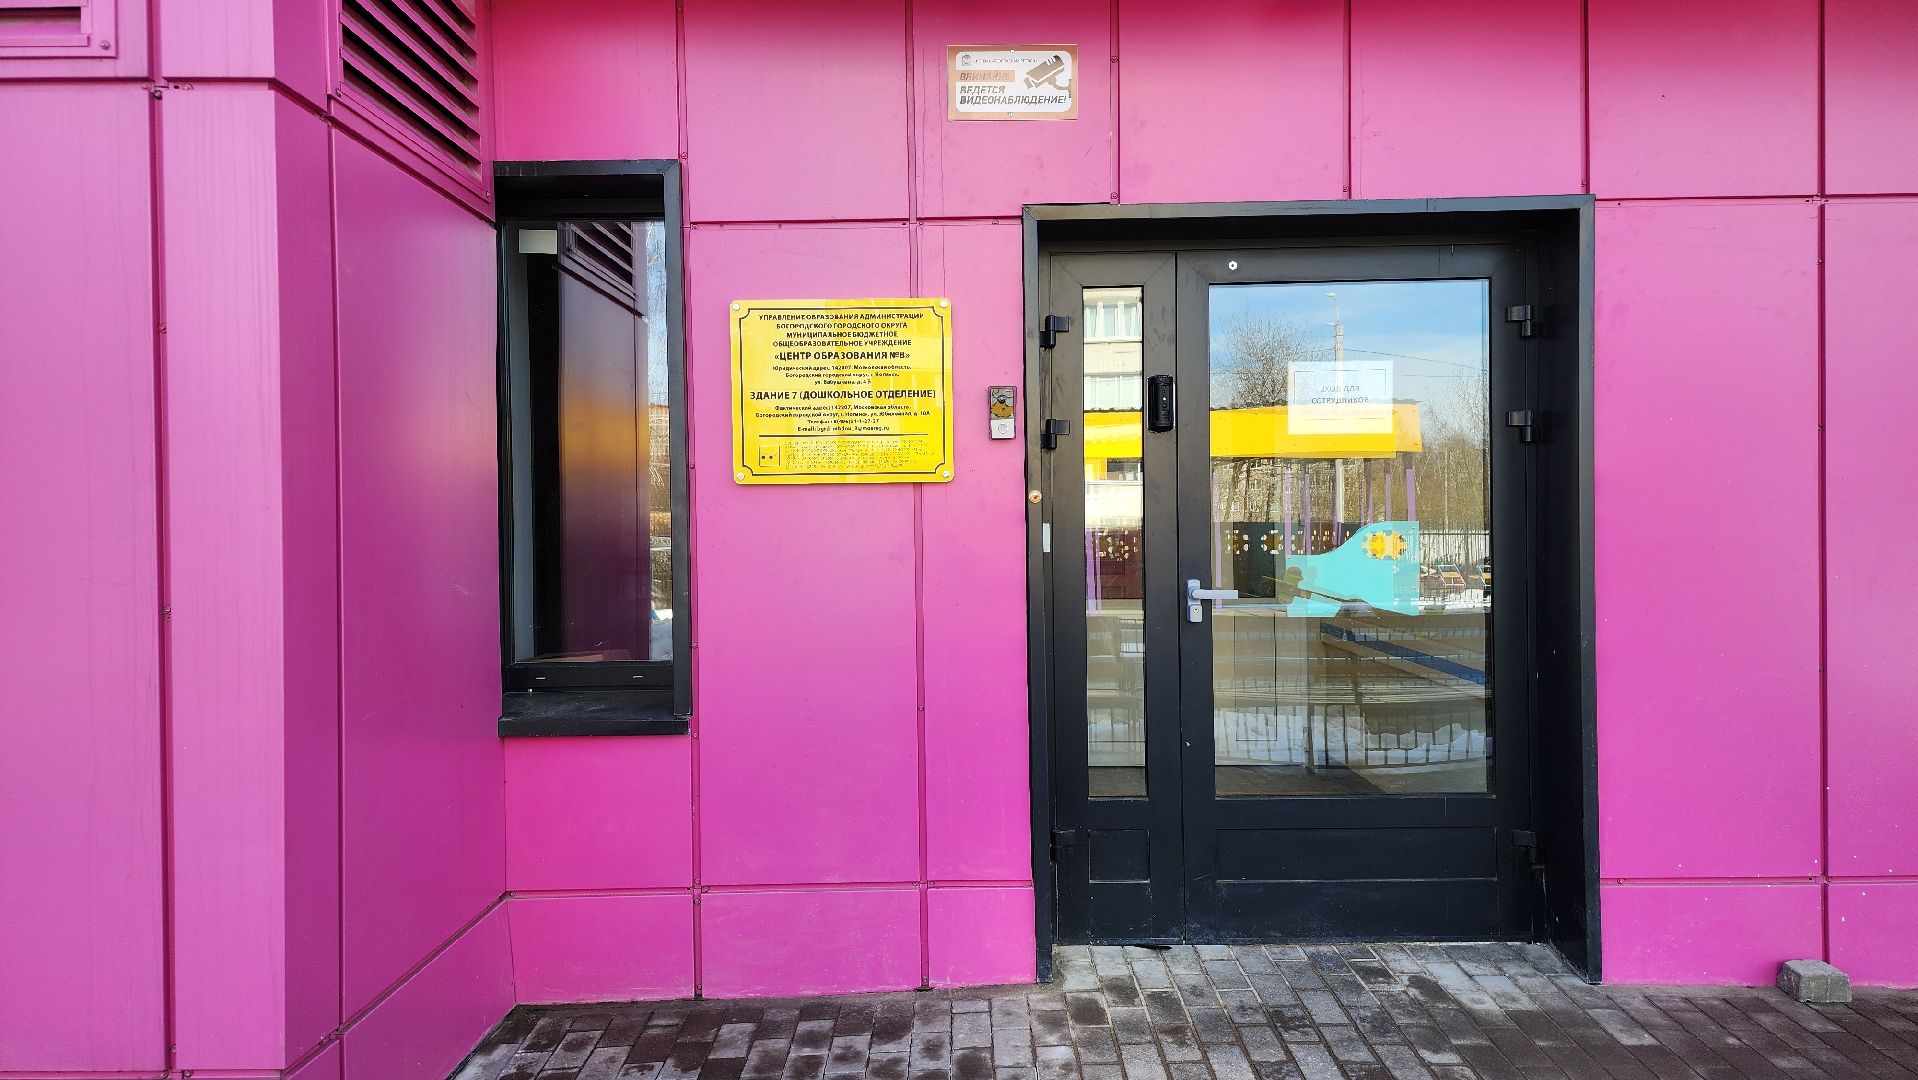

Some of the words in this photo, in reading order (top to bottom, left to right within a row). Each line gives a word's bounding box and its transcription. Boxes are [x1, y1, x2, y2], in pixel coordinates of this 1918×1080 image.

[959, 85, 1006, 95] ВЕДЕТСЯ
[959, 95, 1067, 105] ВИДЕОНАБЛЮДЕНИЕ!
[774, 352, 812, 362] «ЦЕНТР
[814, 352, 888, 360] ОБРАЗОВАНИЯ
[750, 391, 790, 400] ЗДАНИЕ
[792, 391, 797, 400] 7
[800, 390, 874, 400] (ДОШКОЛЬНОЕ
[875, 389, 936, 400] ОТДЕЛЕНИЕ)
[1311, 396, 1369, 405] СОТРУДНИКОВ
